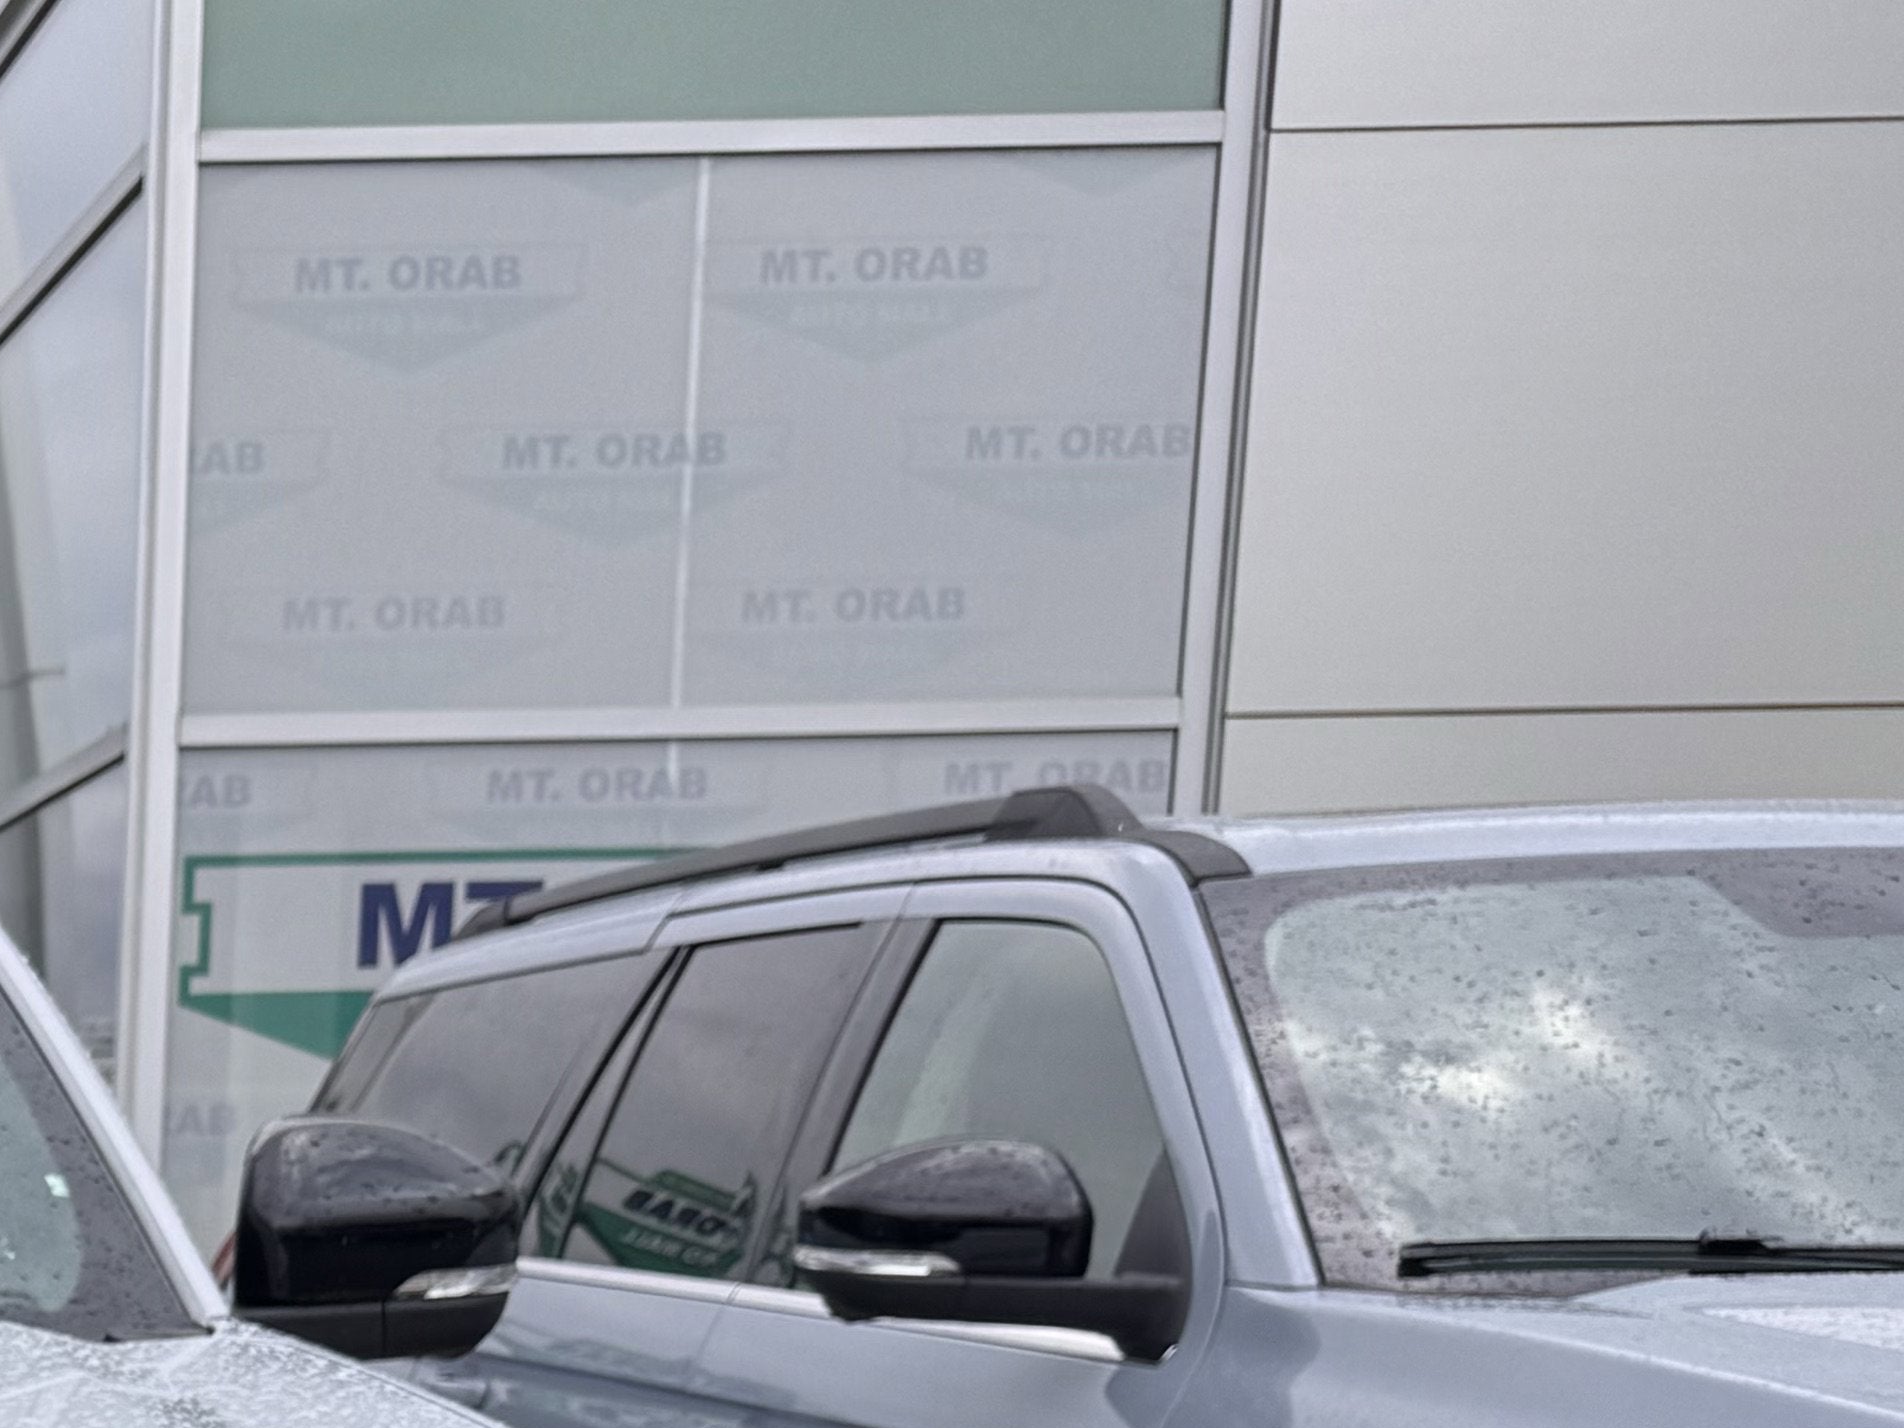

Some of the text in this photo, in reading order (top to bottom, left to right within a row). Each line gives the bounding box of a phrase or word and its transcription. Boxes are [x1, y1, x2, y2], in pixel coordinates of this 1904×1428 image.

[294, 254, 522, 293] MT. ORAB
[759, 246, 988, 284] MT. ORAB
[503, 431, 726, 469] MT. ORAB
[966, 423, 1191, 460] MT. ORAB
[283, 595, 506, 632] MT. ORAB
[835, 587, 965, 622] ORAB
[486, 766, 708, 803] MT. ORAB
